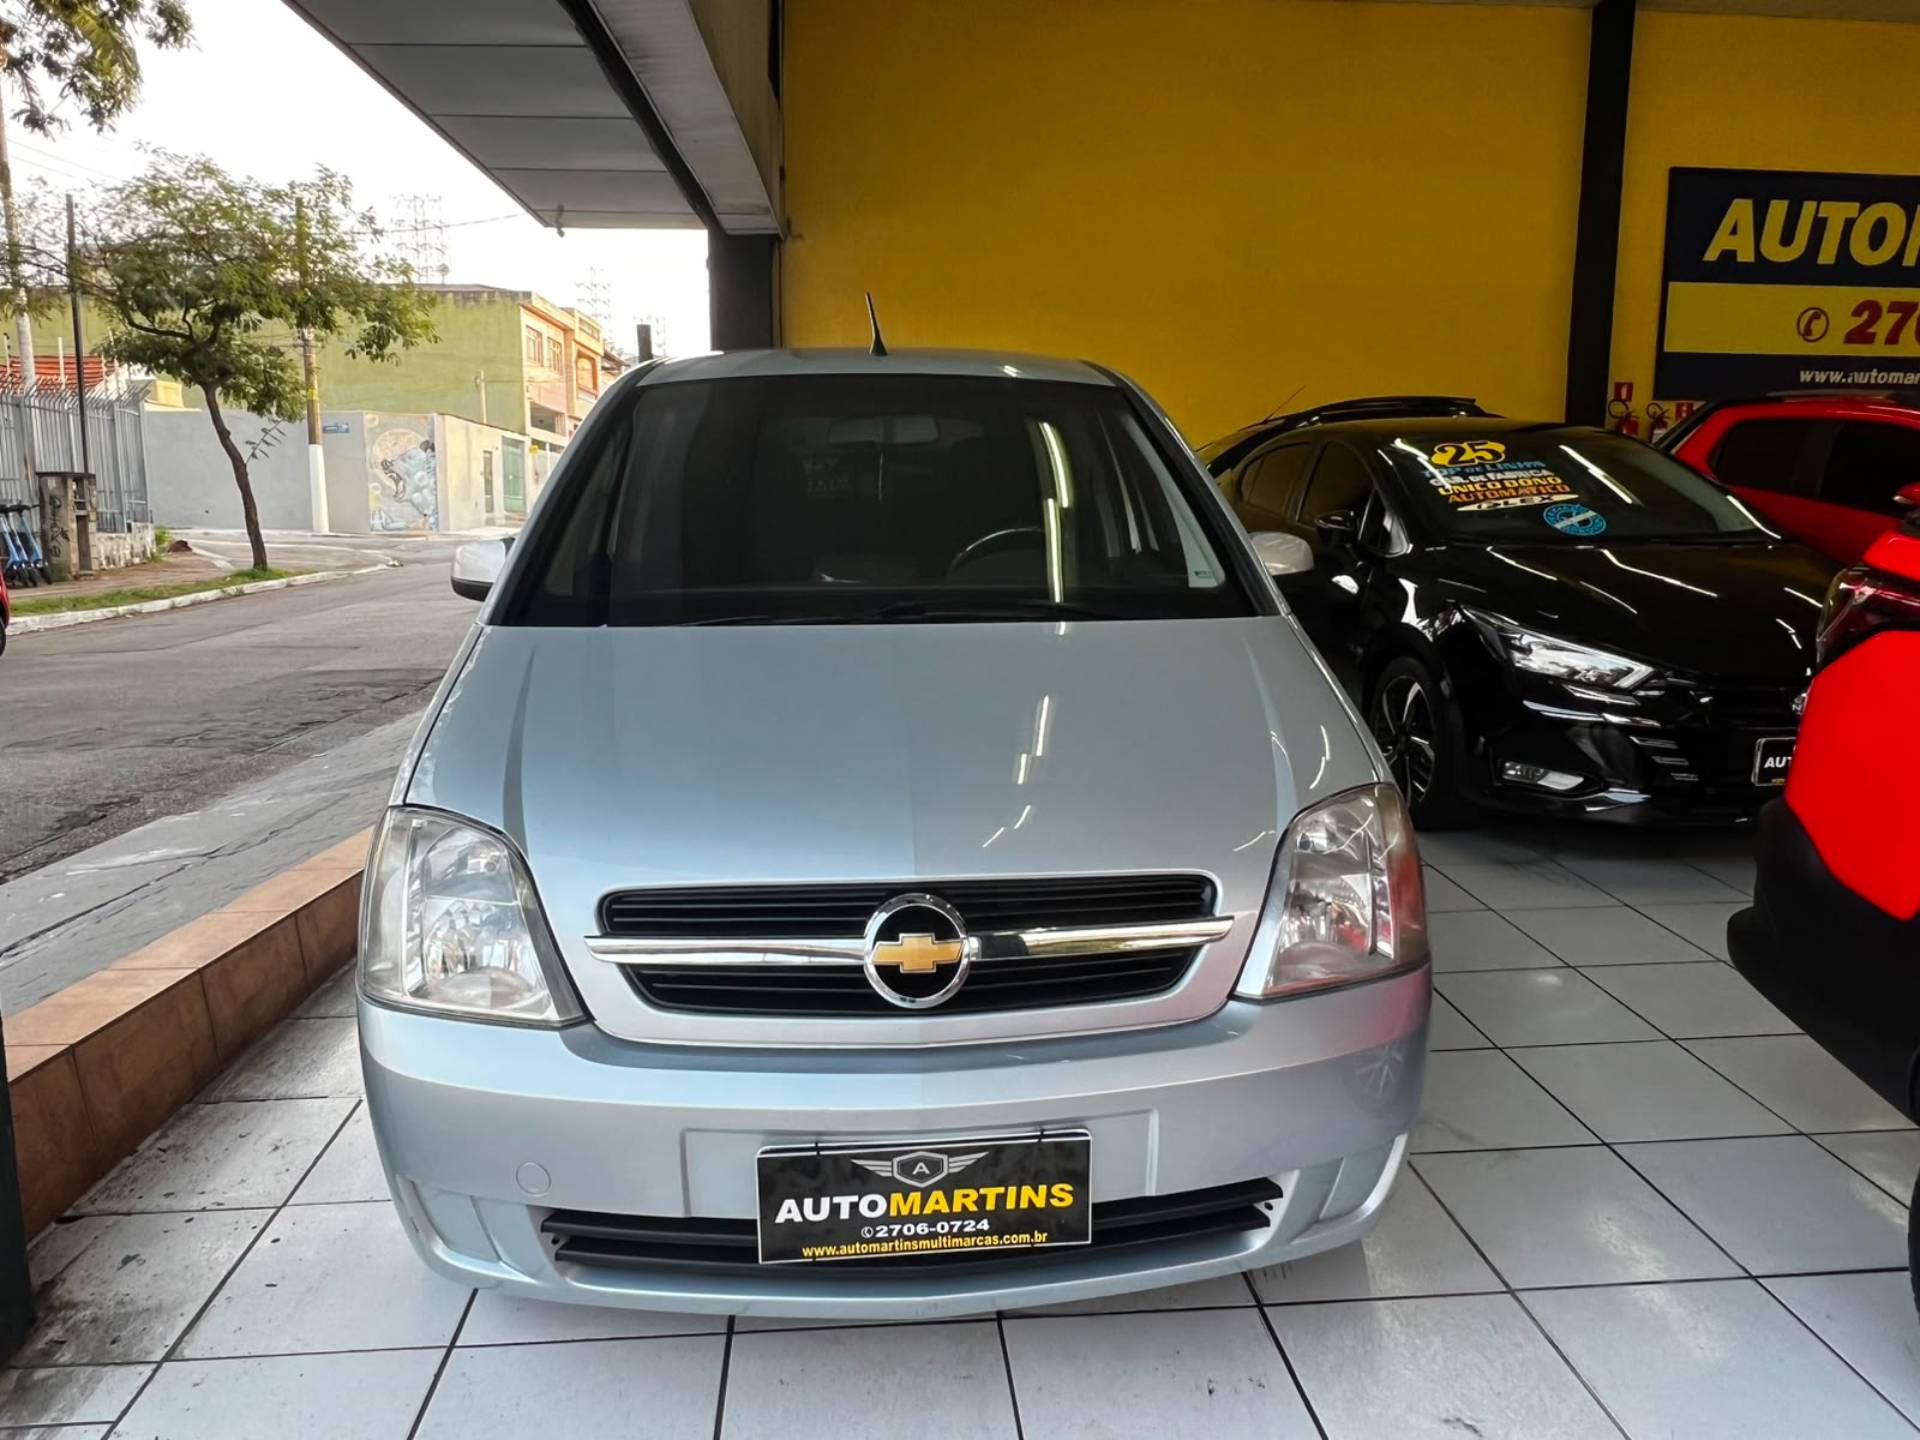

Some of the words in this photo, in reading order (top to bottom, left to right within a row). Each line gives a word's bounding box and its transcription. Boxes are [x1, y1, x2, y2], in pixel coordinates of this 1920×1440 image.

[1843, 299, 1920, 346] 27
[1433, 440, 1506, 467] 25
[1504, 476, 1562, 488] DONO
[912, 1162, 930, 1175] A
[774, 1183, 1075, 1224] AUTOMARTINS
[876, 1218, 990, 1238] 2706-0724
[802, 1230, 1048, 1257] www.automartinsmultimarcas.com.br
